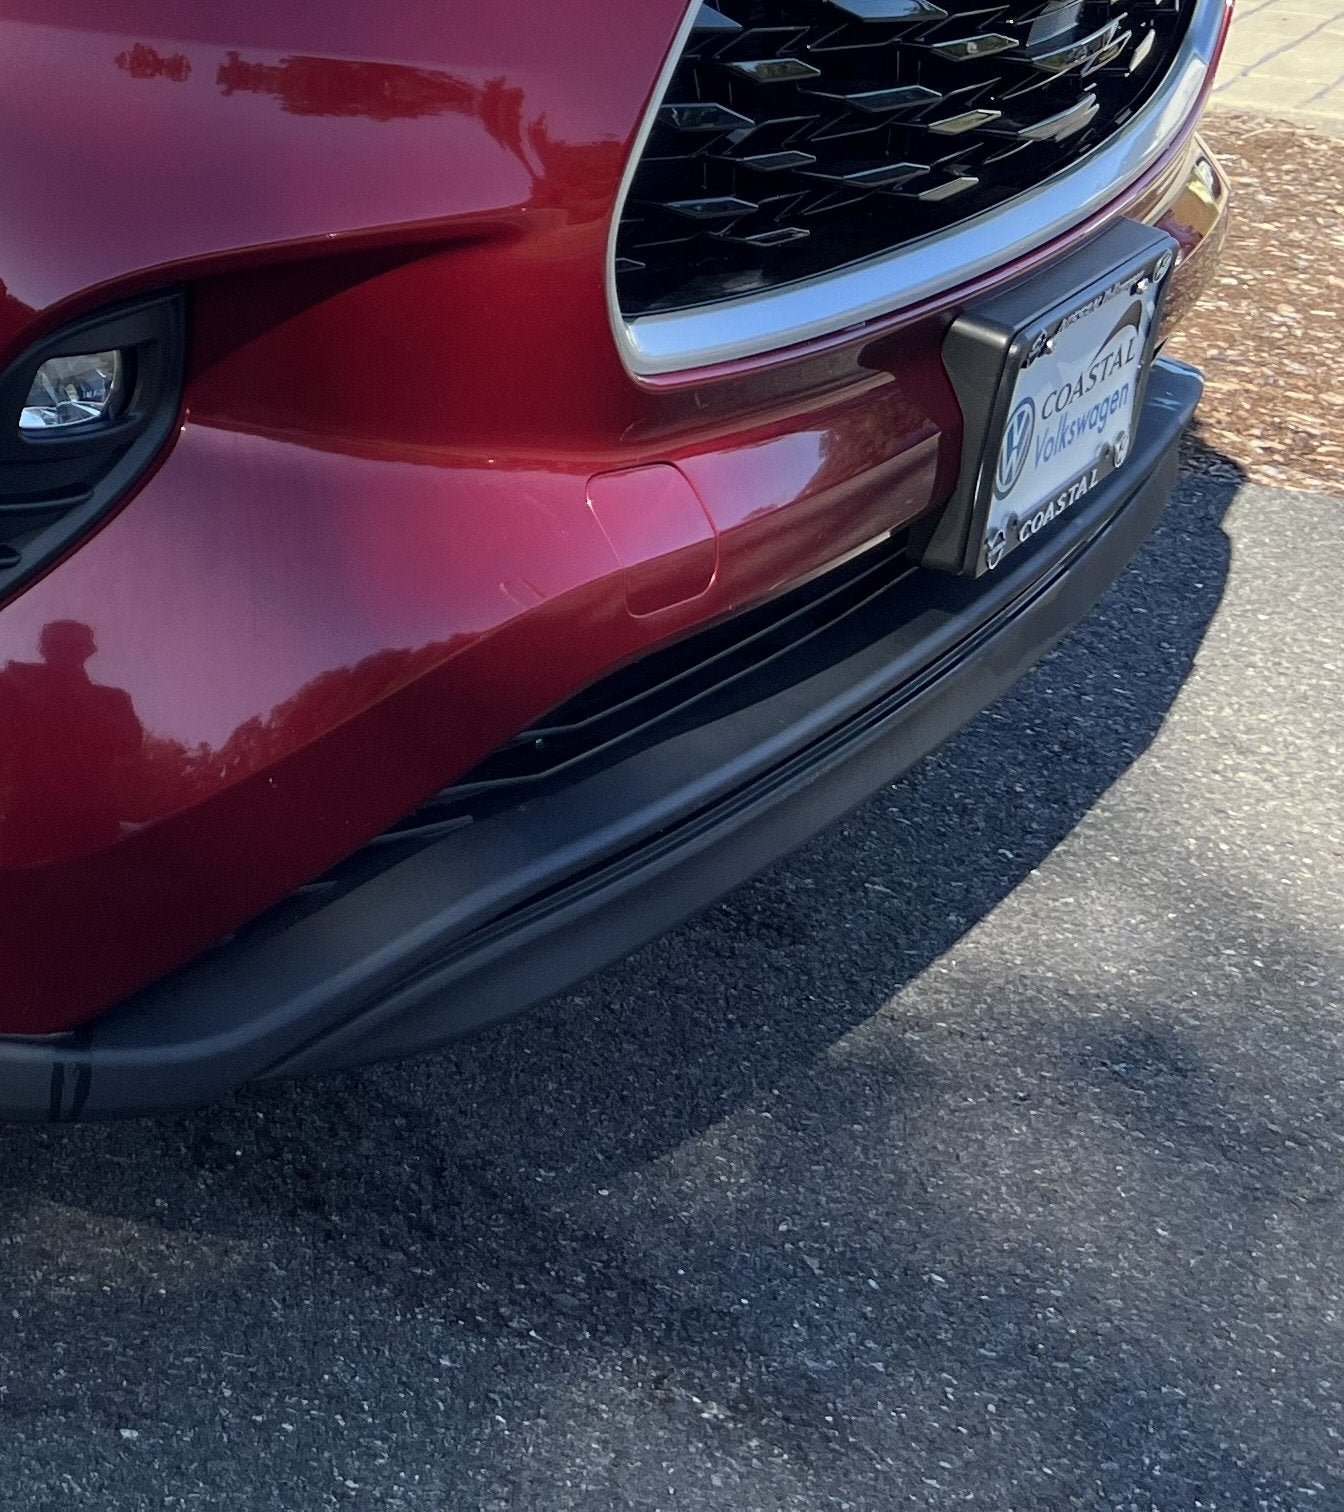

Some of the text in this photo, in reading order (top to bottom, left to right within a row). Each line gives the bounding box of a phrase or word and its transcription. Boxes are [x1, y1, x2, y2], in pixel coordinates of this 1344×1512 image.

[1041, 337, 1136, 420] COASTAL
[1035, 382, 1130, 470] Volkswagen
[1018, 468, 1100, 543] COASTAL
